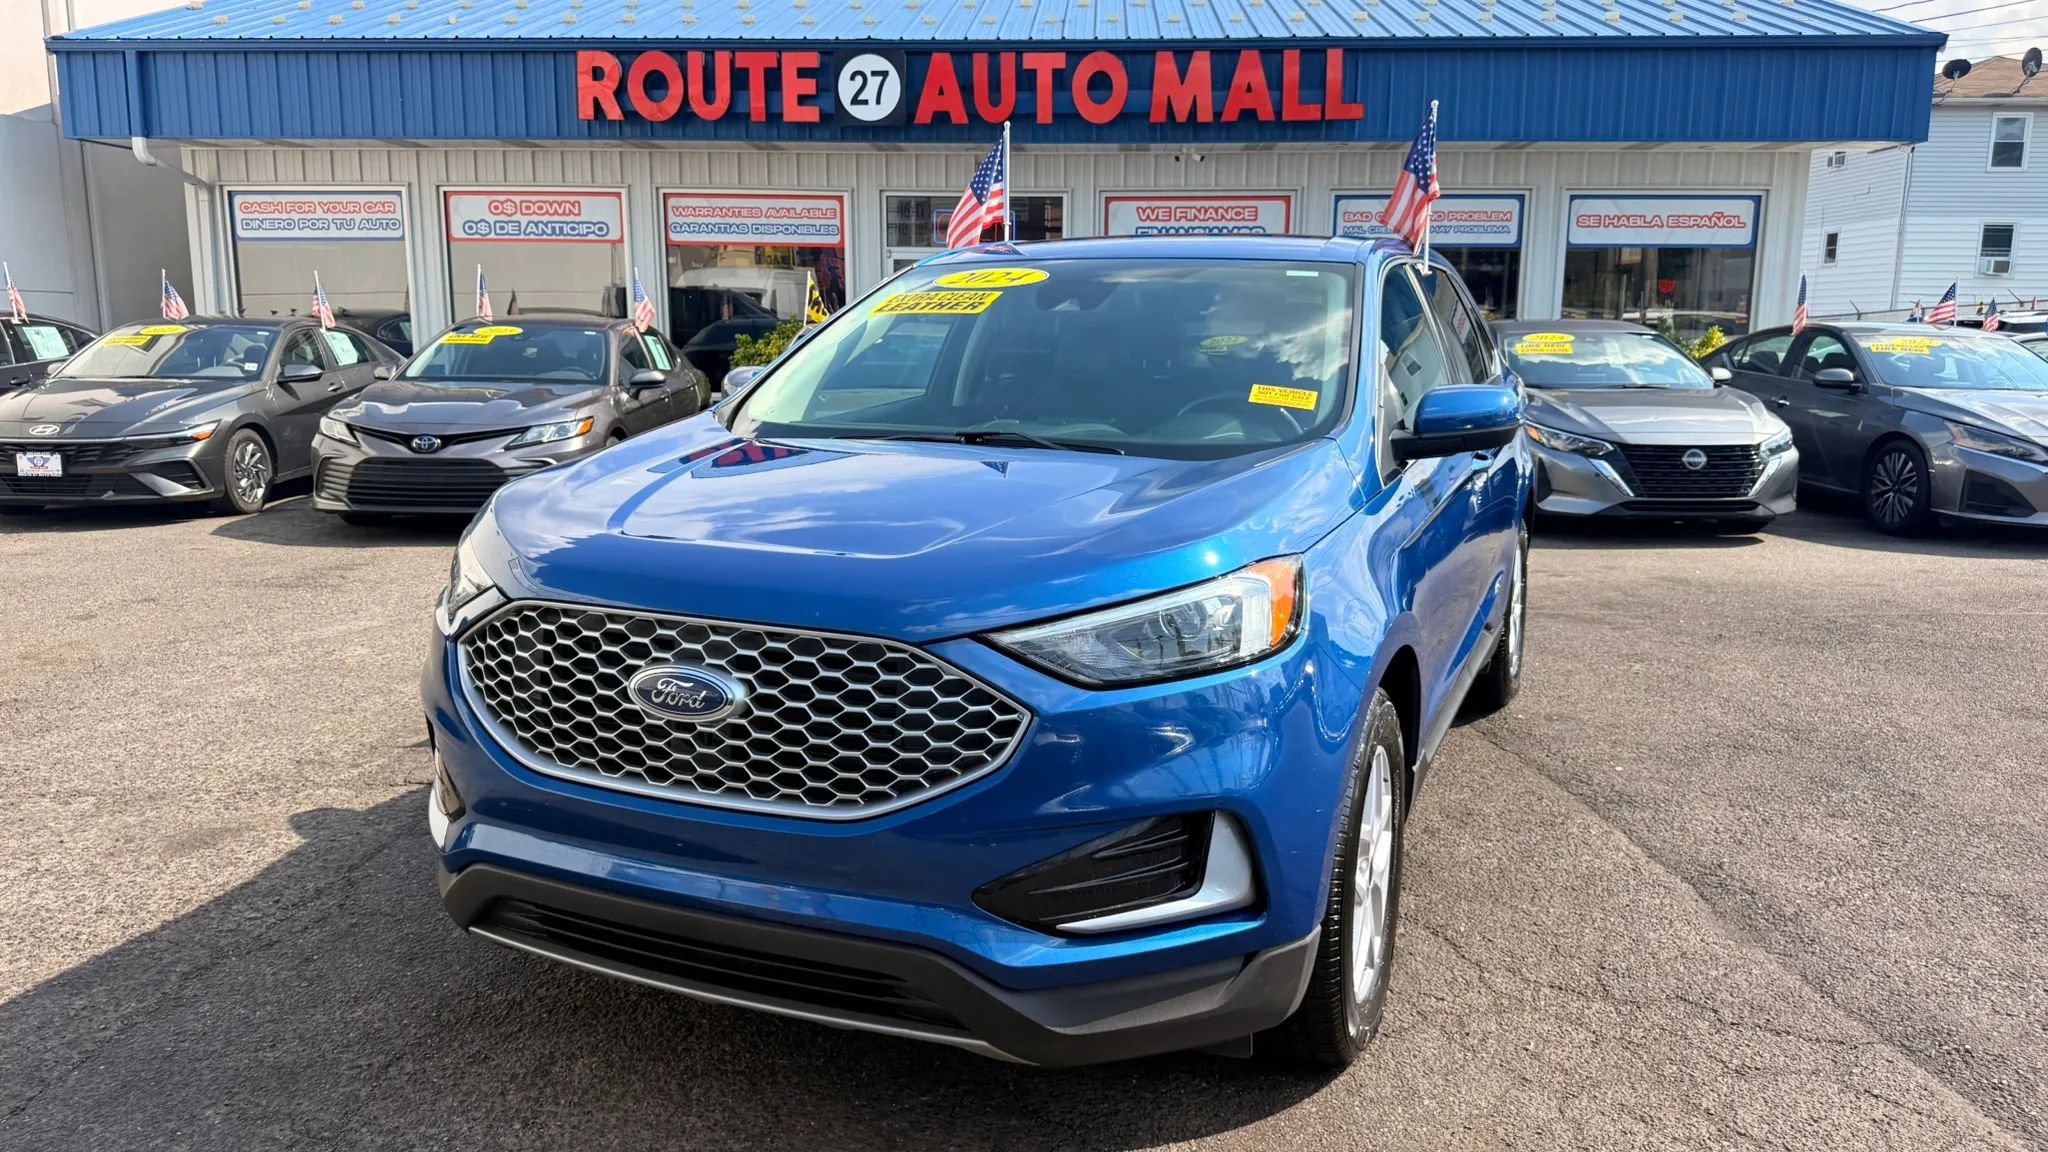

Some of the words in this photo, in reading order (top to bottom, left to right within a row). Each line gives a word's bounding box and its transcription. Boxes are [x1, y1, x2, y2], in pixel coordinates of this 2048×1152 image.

[576, 50, 821, 124] ROUTE
[849, 70, 889, 106] 27
[914, 50, 1128, 125] AUTO
[1149, 48, 1364, 124] MALL
[240, 201, 282, 214] CASH
[286, 201, 316, 214] FOR
[319, 201, 360, 214] YOUR
[363, 201, 396, 214] CAR
[519, 200, 581, 216] DOWN
[672, 206, 763, 218] WARRANTIES
[764, 207, 837, 219] AVAILABLE
[1136, 206, 1172, 222] WE
[1174, 206, 1258, 222] FINANCE
[1343, 211, 1373, 223] BAD
[1448, 210, 1513, 222] PROBLEM
[1576, 214, 1601, 229] SE
[1603, 214, 1664, 229] HABLA
[1666, 211, 1746, 229] ESPAÑOL
[241, 218, 296, 230] DINERO
[298, 218, 329, 230] POR
[332, 219, 355, 230] TU
[358, 219, 400, 230] AUTO
[494, 221, 521, 236] DE
[523, 221, 609, 237] ANTICIPO
[670, 222, 749, 235] GARANTIAS
[751, 224, 839, 236] DISPONIBLES
[1343, 225, 1367, 235] MAL
[1454, 224, 1511, 234] PROBLEMA
[874, 301, 986, 312] LEATHER
[651, 677, 707, 708] Ford
